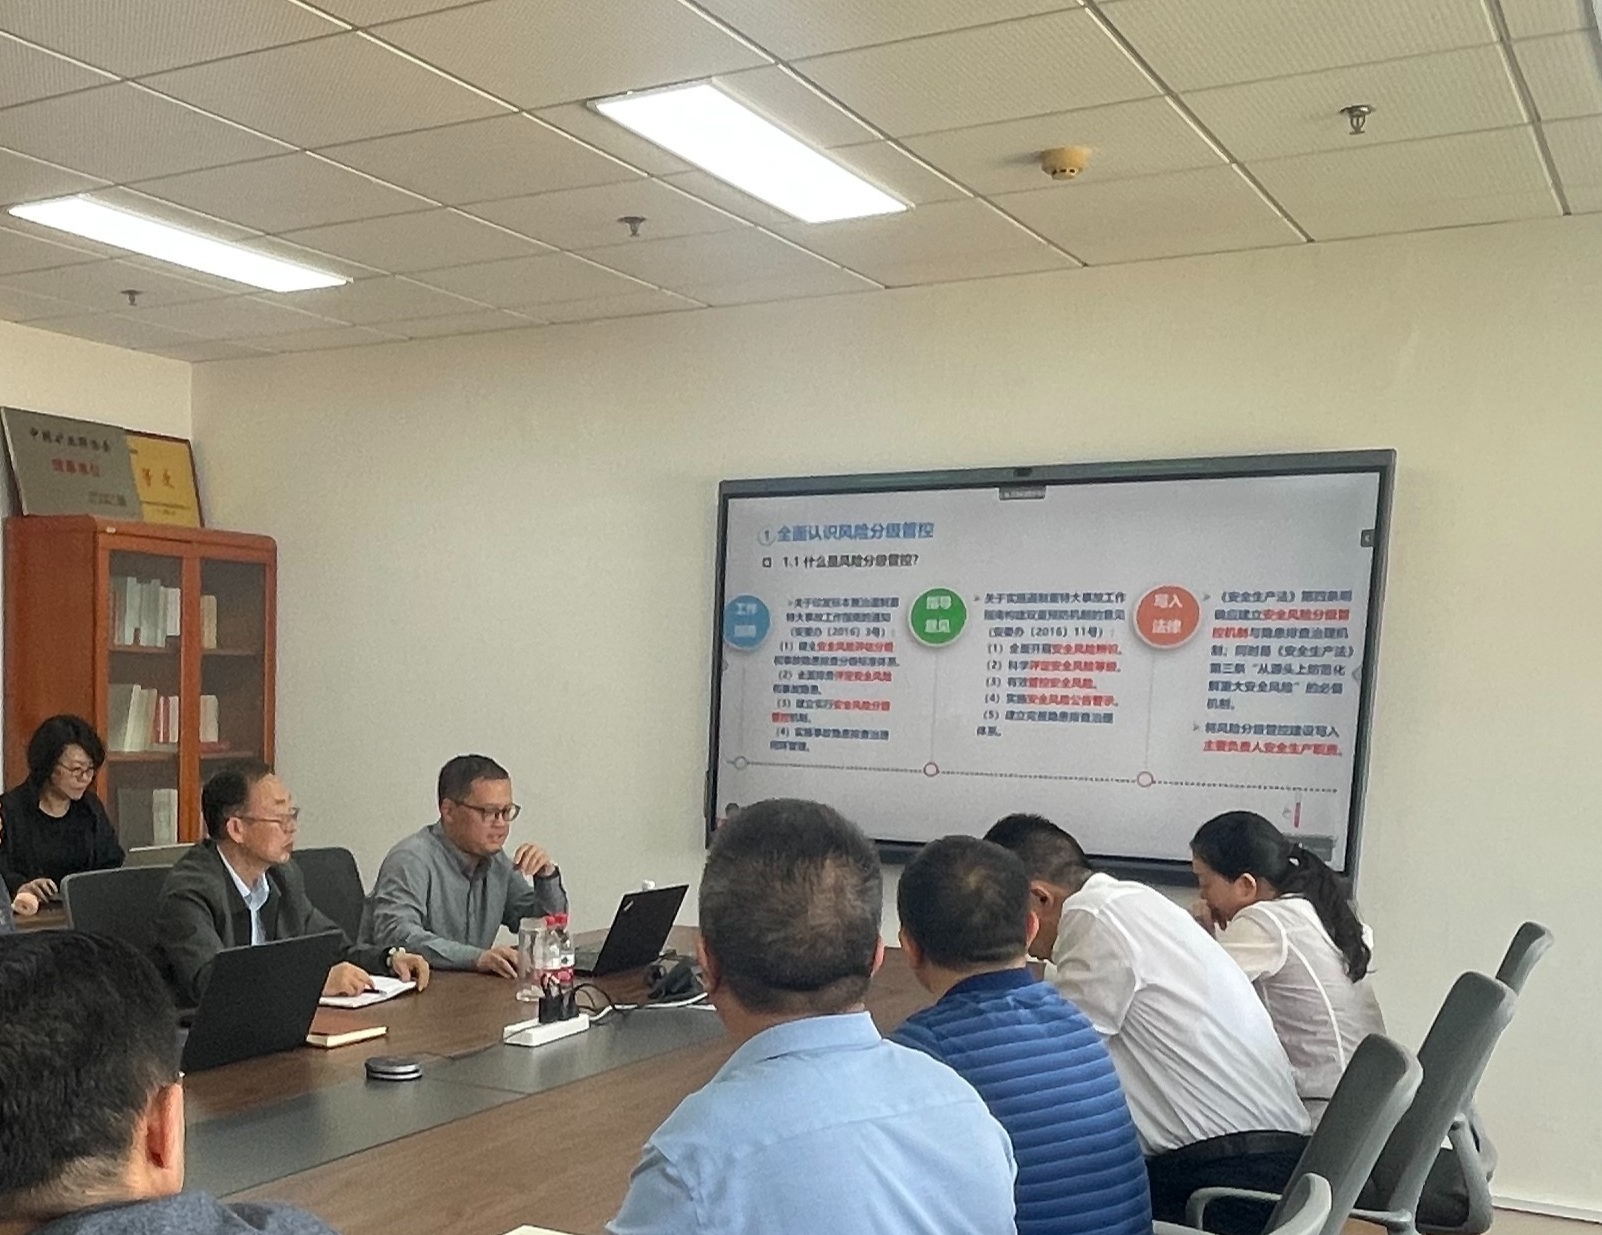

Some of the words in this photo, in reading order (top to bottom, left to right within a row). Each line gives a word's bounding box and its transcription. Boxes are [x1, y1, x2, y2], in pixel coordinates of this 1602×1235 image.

[777, 522, 935, 542] 全面认识风险分级管控
[1154, 593, 1183, 609] 写入
